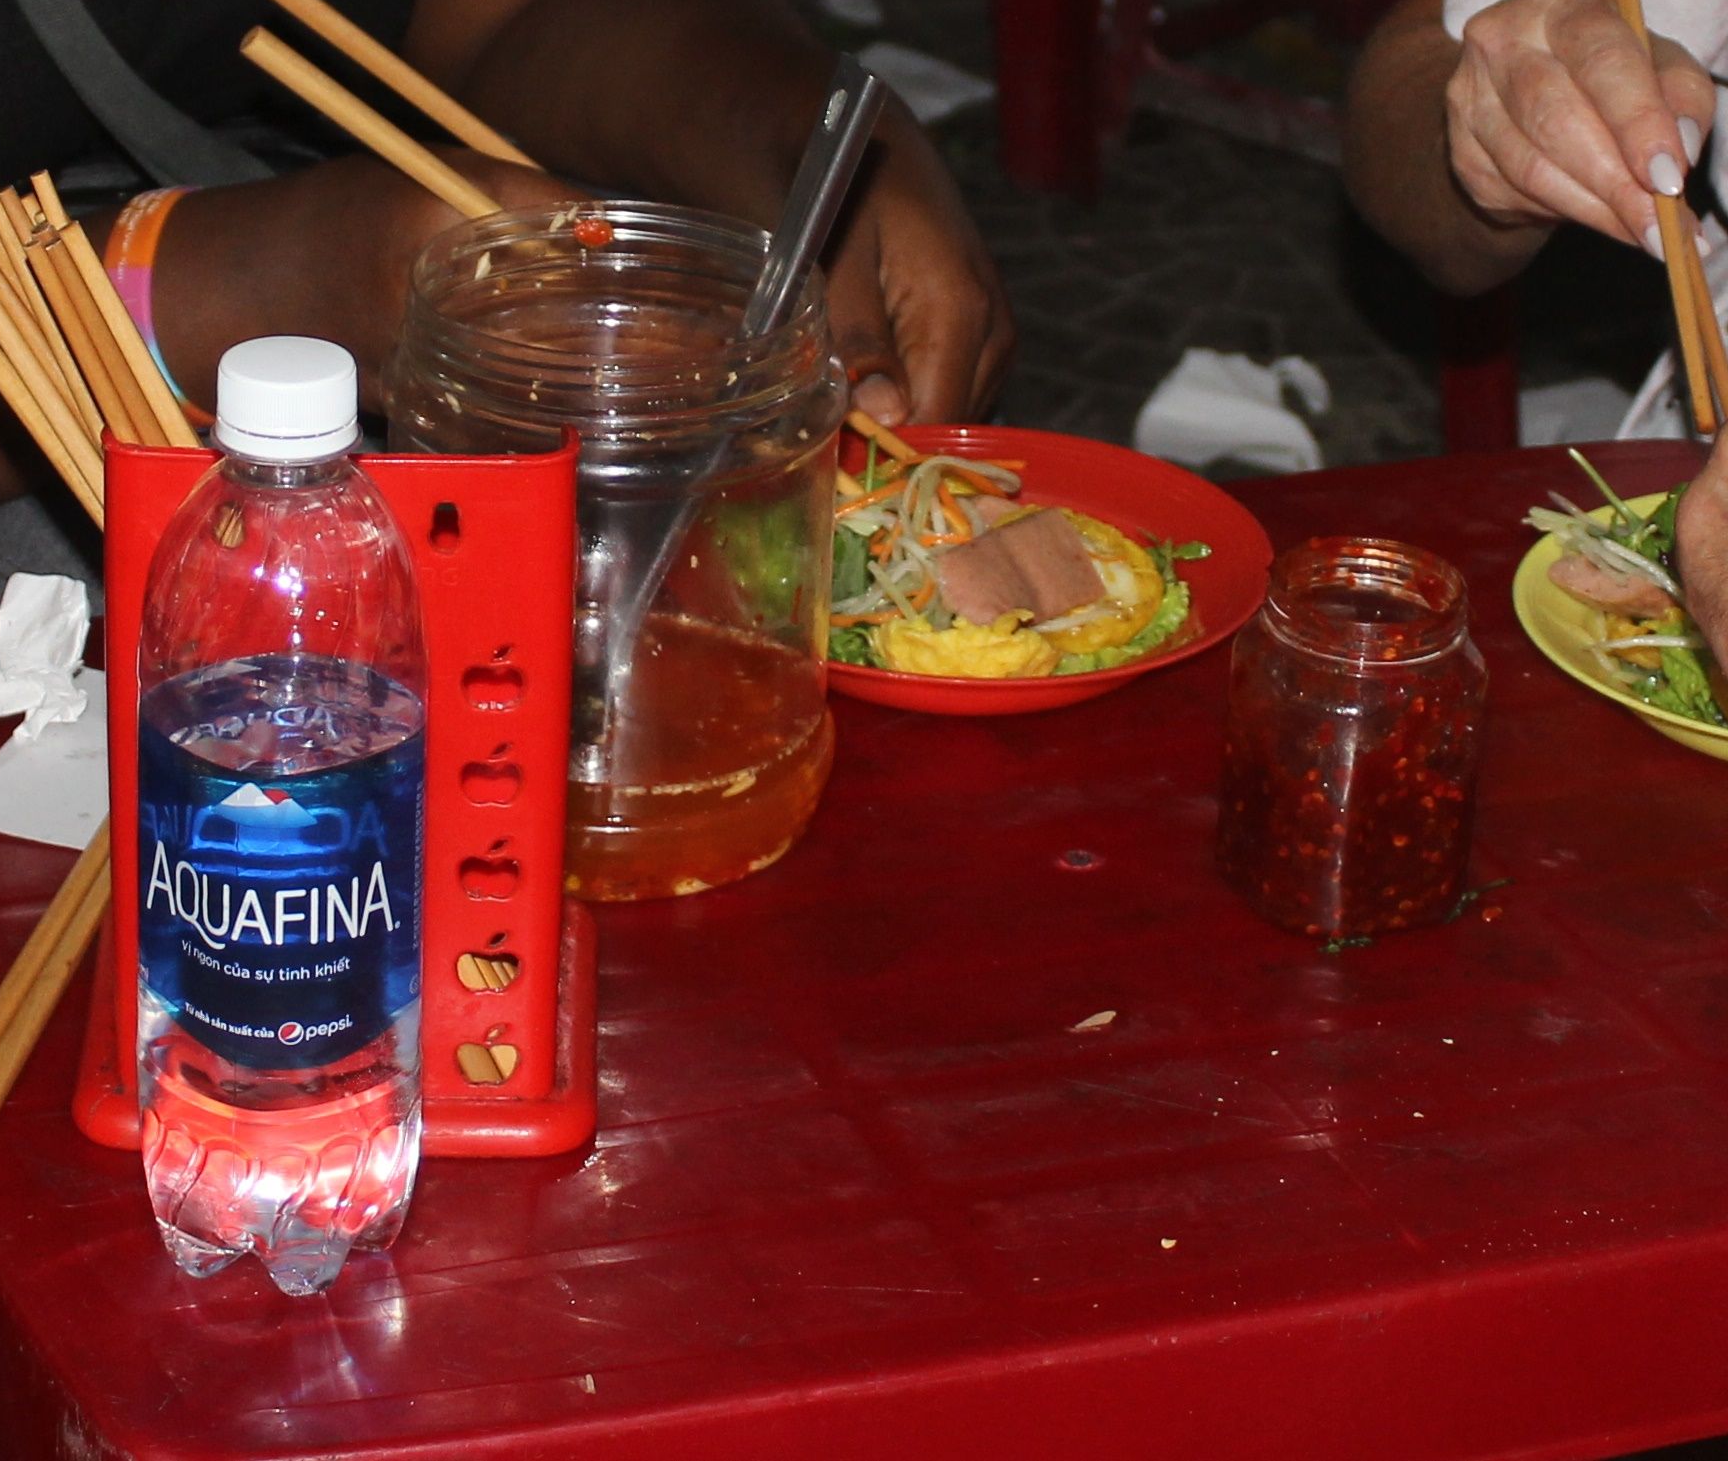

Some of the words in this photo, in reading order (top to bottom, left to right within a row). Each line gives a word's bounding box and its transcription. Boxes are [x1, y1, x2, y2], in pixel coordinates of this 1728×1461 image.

[147, 840, 395, 949] AQUAFINA
[193, 947, 221, 971] ngon
[224, 962, 250, 979] của
[255, 969, 274, 984] sự
[278, 967, 310, 981] tinh
[315, 956, 350, 978] khiết
[305, 1014, 351, 1041] pepsi
